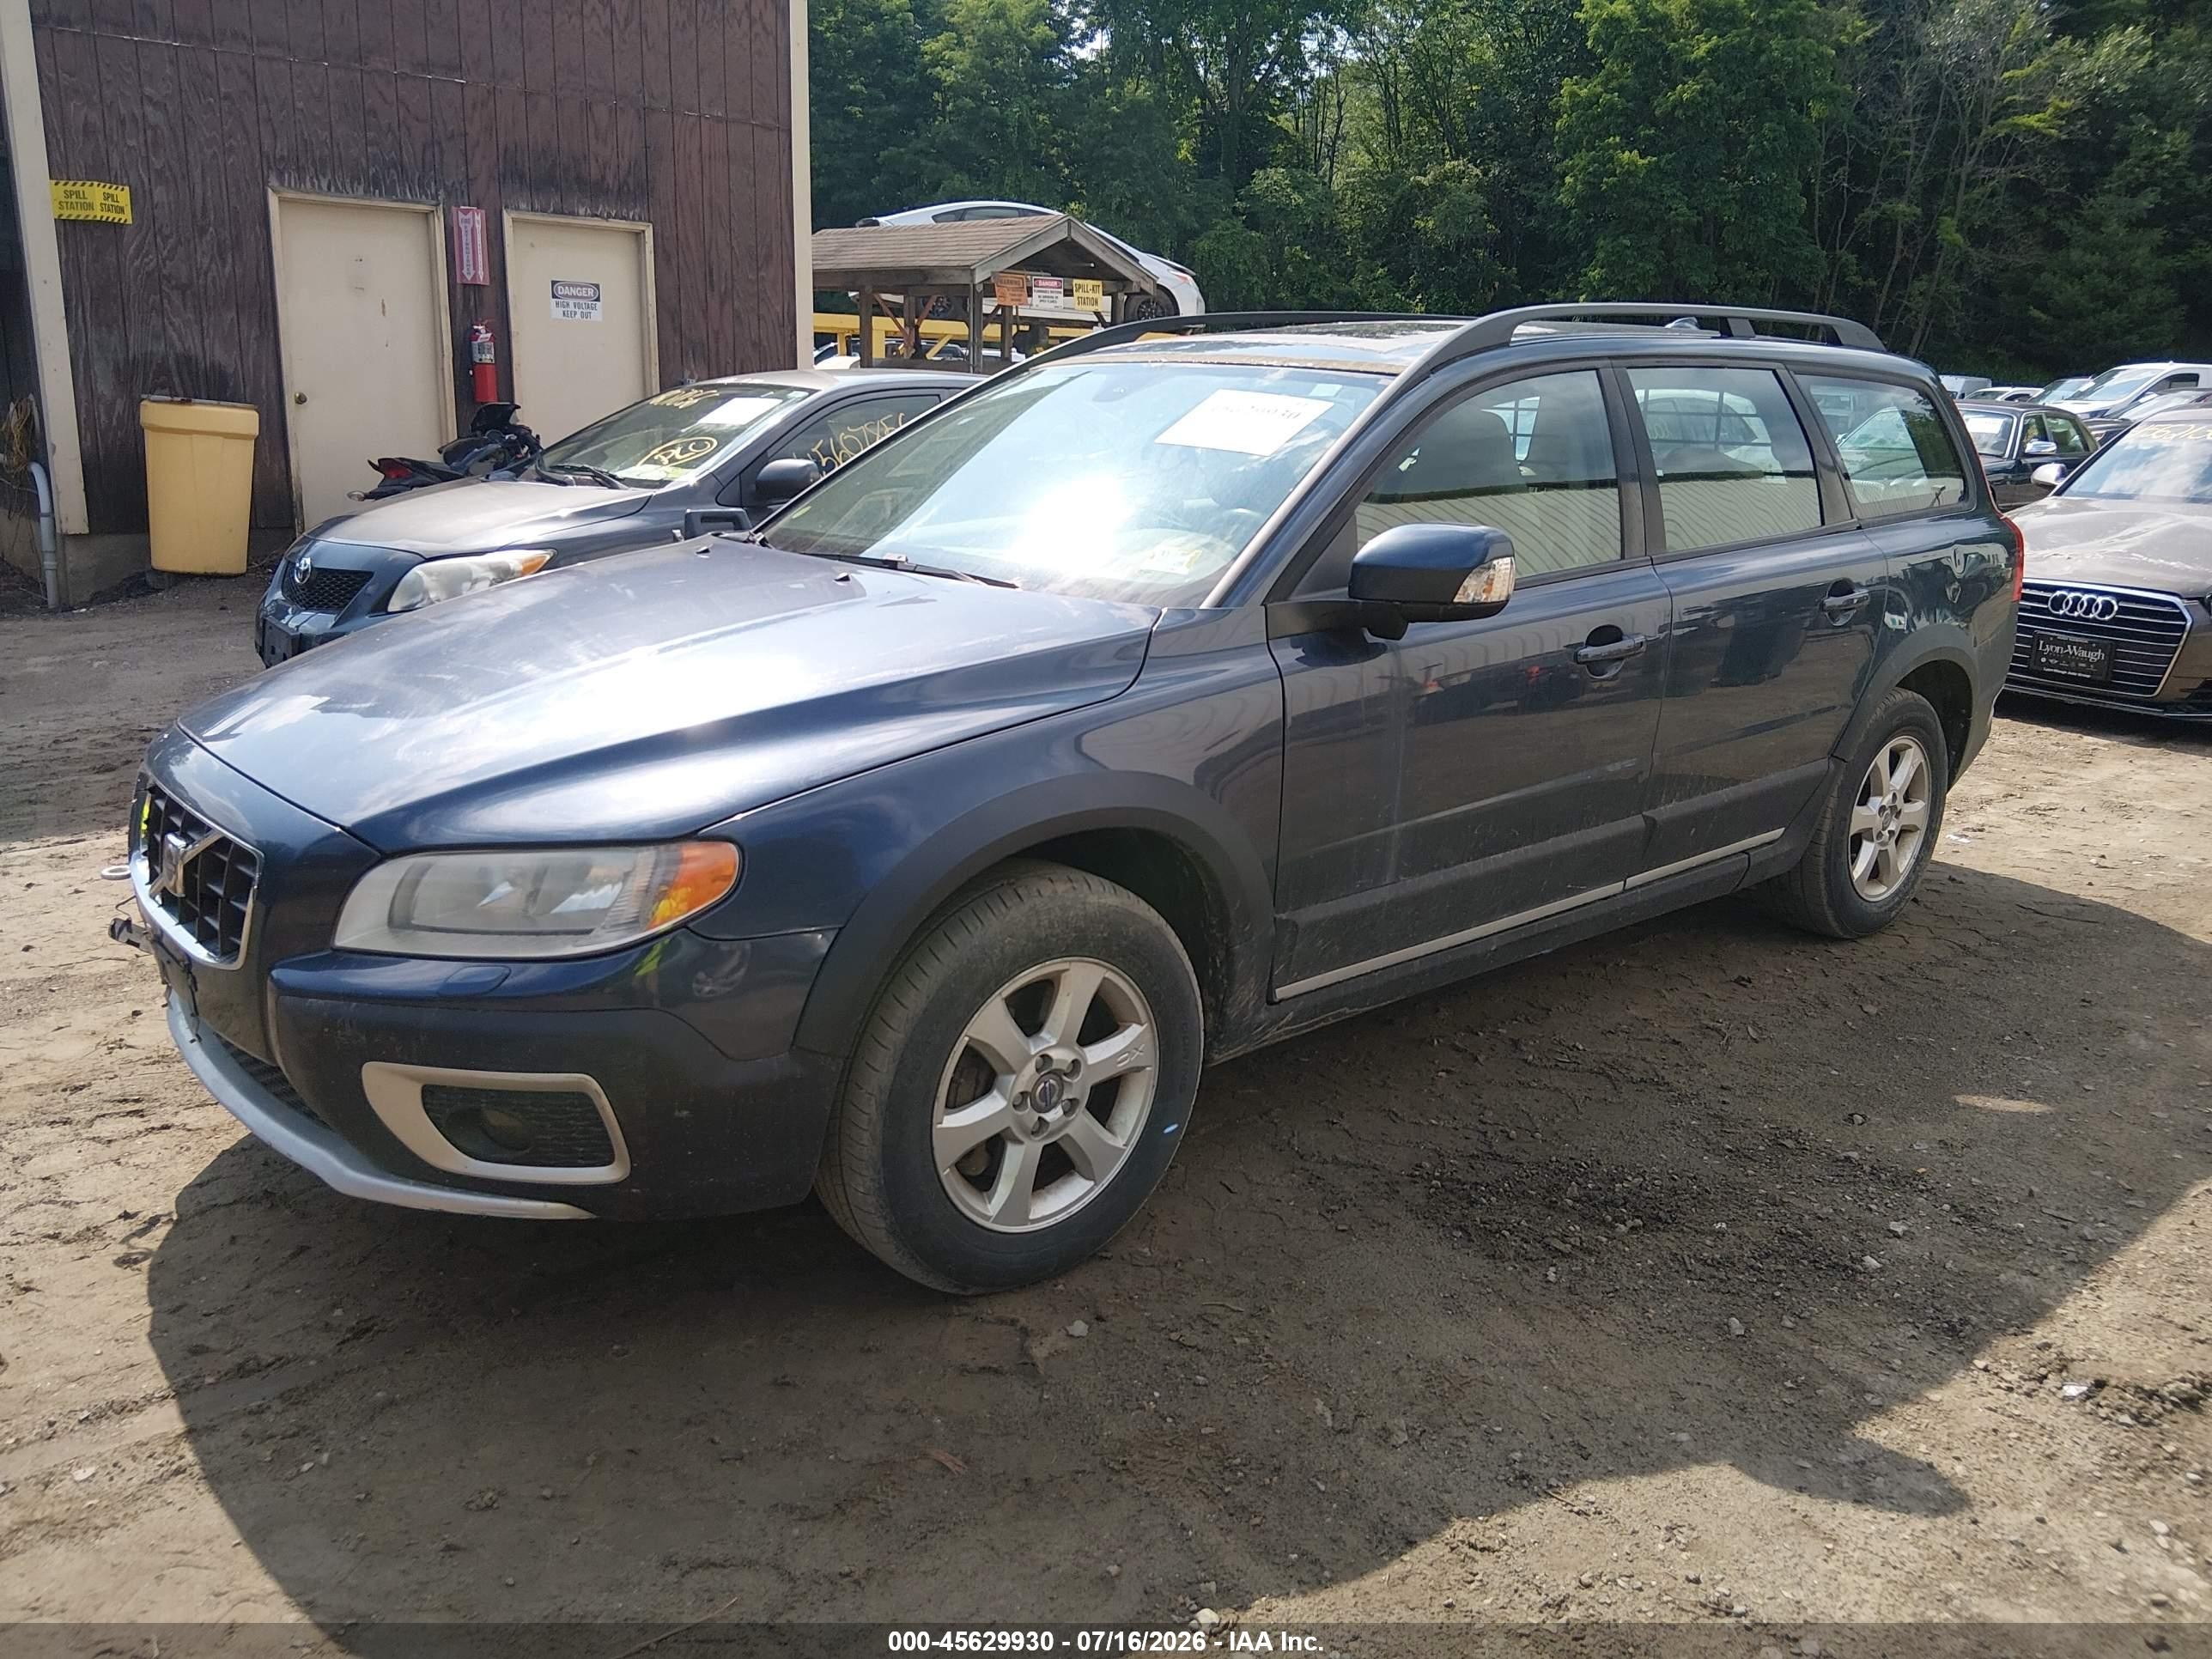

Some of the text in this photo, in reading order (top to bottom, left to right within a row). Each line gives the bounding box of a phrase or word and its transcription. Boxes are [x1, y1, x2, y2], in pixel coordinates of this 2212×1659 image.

[64, 190, 88, 199] SPILL
[102, 191, 119, 203] SPILL
[58, 201, 94, 211] STATION
[100, 203, 125, 215] STATION
[557, 286, 594, 297] DANGER
[1074, 283, 1100, 293] SPILL-KIT
[555, 301, 598, 311] HIGH VOLTAGE
[1077, 295, 1099, 307] STATION
[562, 310, 592, 319] KEEP OUT
[2038, 640, 2105, 663] Lyon-Waugh
